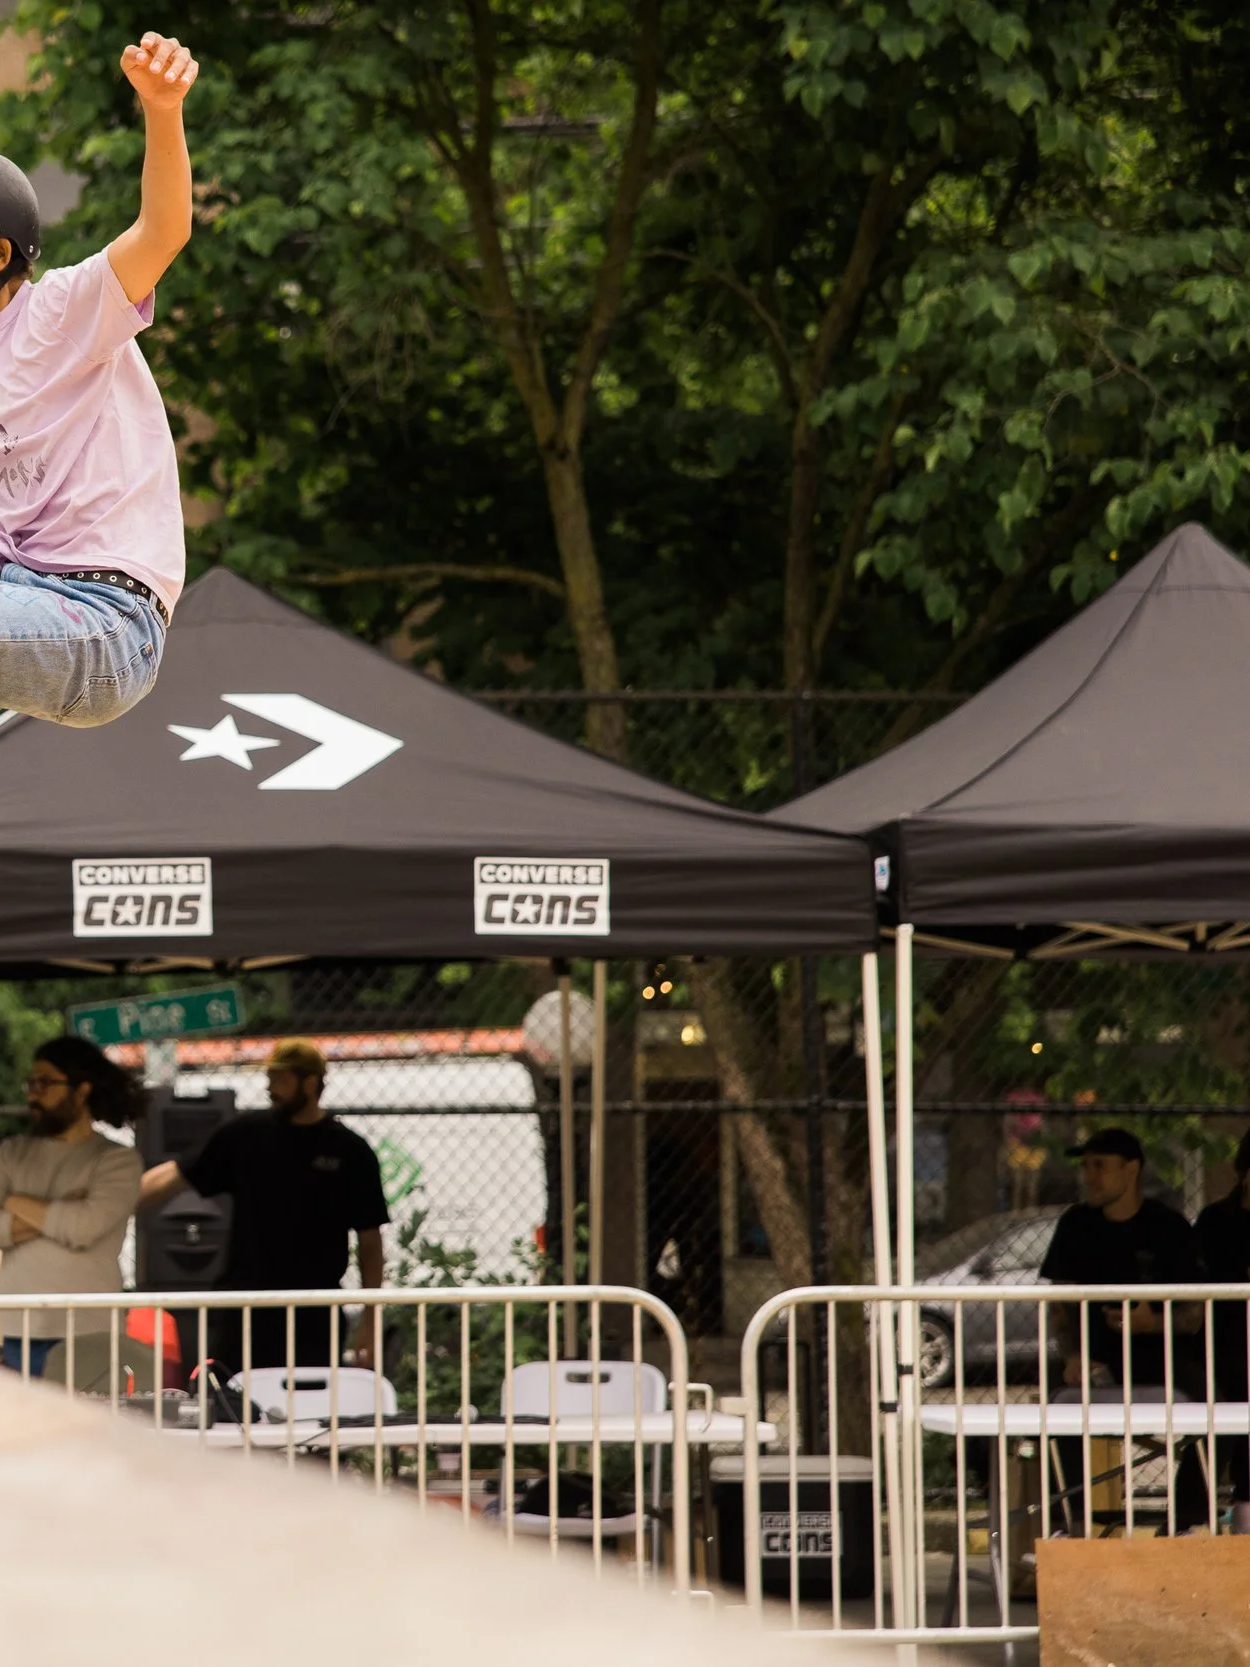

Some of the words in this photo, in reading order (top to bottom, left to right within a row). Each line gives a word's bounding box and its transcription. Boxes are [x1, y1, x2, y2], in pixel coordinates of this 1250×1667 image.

[81, 865, 204, 885] CONVERSE
[481, 864, 602, 885] CONVERSE
[118, 1001, 186, 1036] Pine
[206, 998, 232, 1025] St
